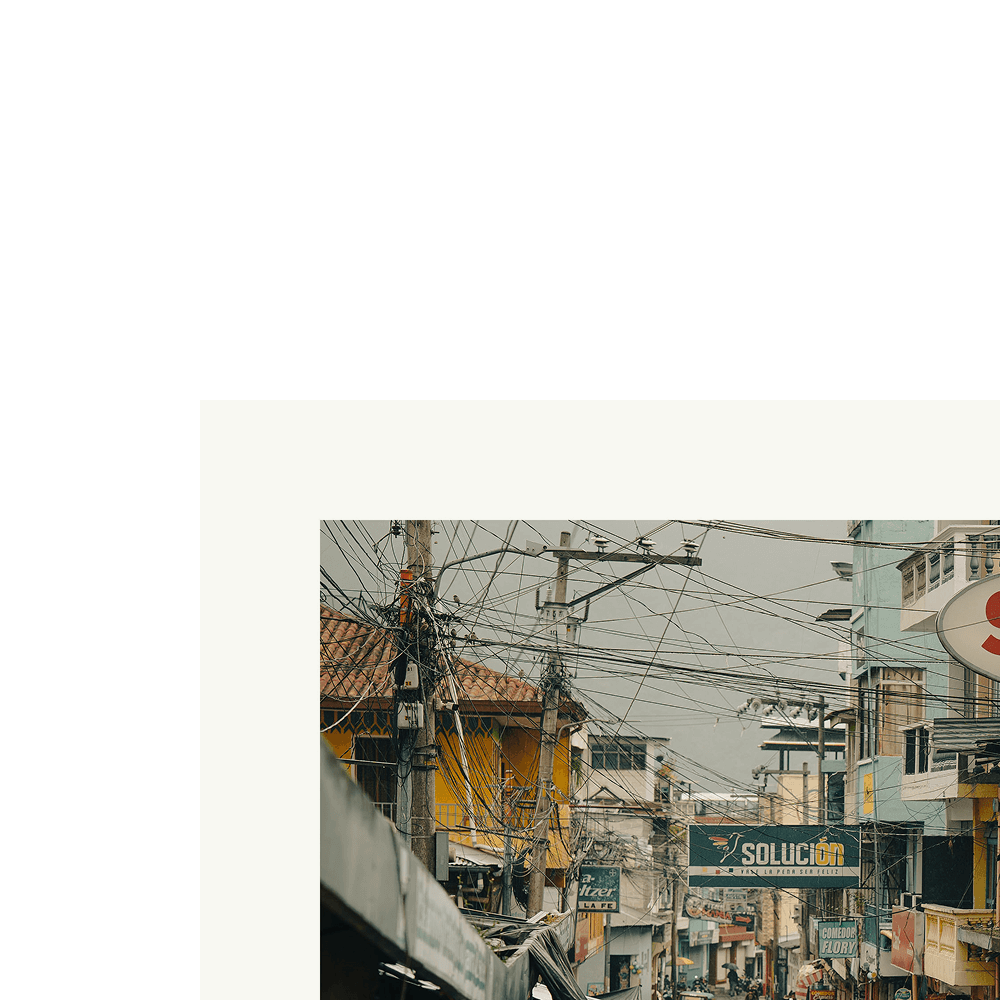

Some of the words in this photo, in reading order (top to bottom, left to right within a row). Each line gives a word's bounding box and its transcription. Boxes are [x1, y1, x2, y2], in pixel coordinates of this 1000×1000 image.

[579, 885, 616, 897] ltzer
[822, 927, 856, 939] COMEDOR
[821, 941, 857, 954] FLORY
